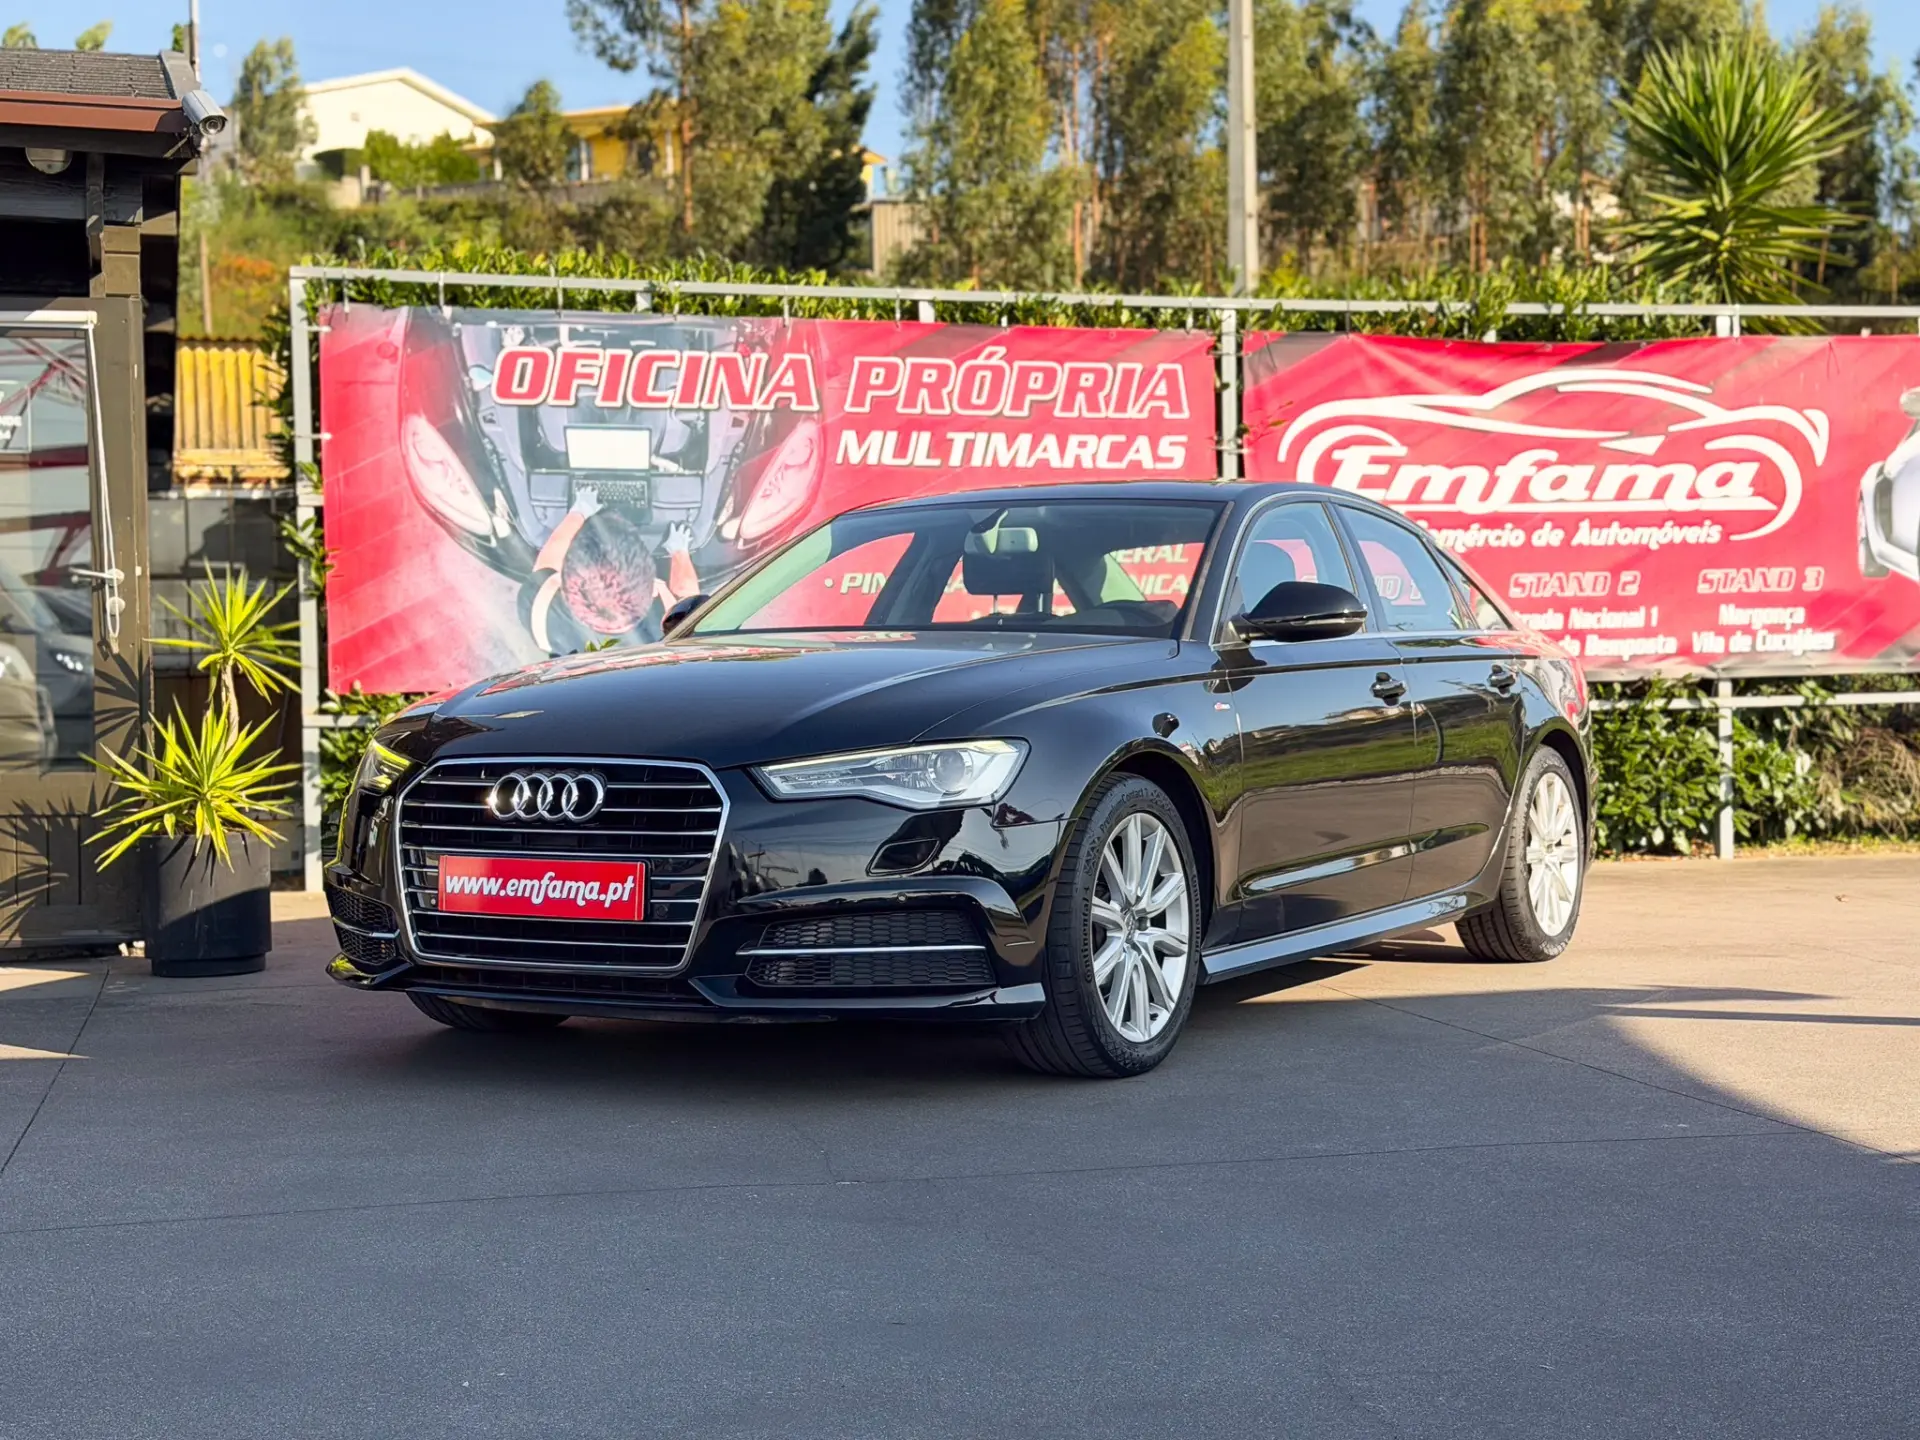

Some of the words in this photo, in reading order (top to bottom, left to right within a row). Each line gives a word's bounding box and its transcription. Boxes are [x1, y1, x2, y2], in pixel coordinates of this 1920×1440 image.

[491, 346, 819, 411] OFICINA
[844, 346, 1190, 419] PRÓPRIA
[836, 430, 1188, 469] MULTIMARCAS
[1330, 445, 1762, 516] Emfama
[1531, 521, 1565, 547] de
[1571, 518, 1723, 550] Automóveis
[1110, 544, 1189, 563] ERAL
[1509, 572, 1611, 598] STAND
[1617, 571, 1641, 596] 2
[1697, 568, 1796, 594] STAND
[1802, 566, 1825, 591] 3
[1568, 606, 1646, 629] Nacional
[1692, 631, 1725, 653] Vila
[1729, 631, 1753, 652] de
[445, 871, 635, 908] www.emfama.pt
